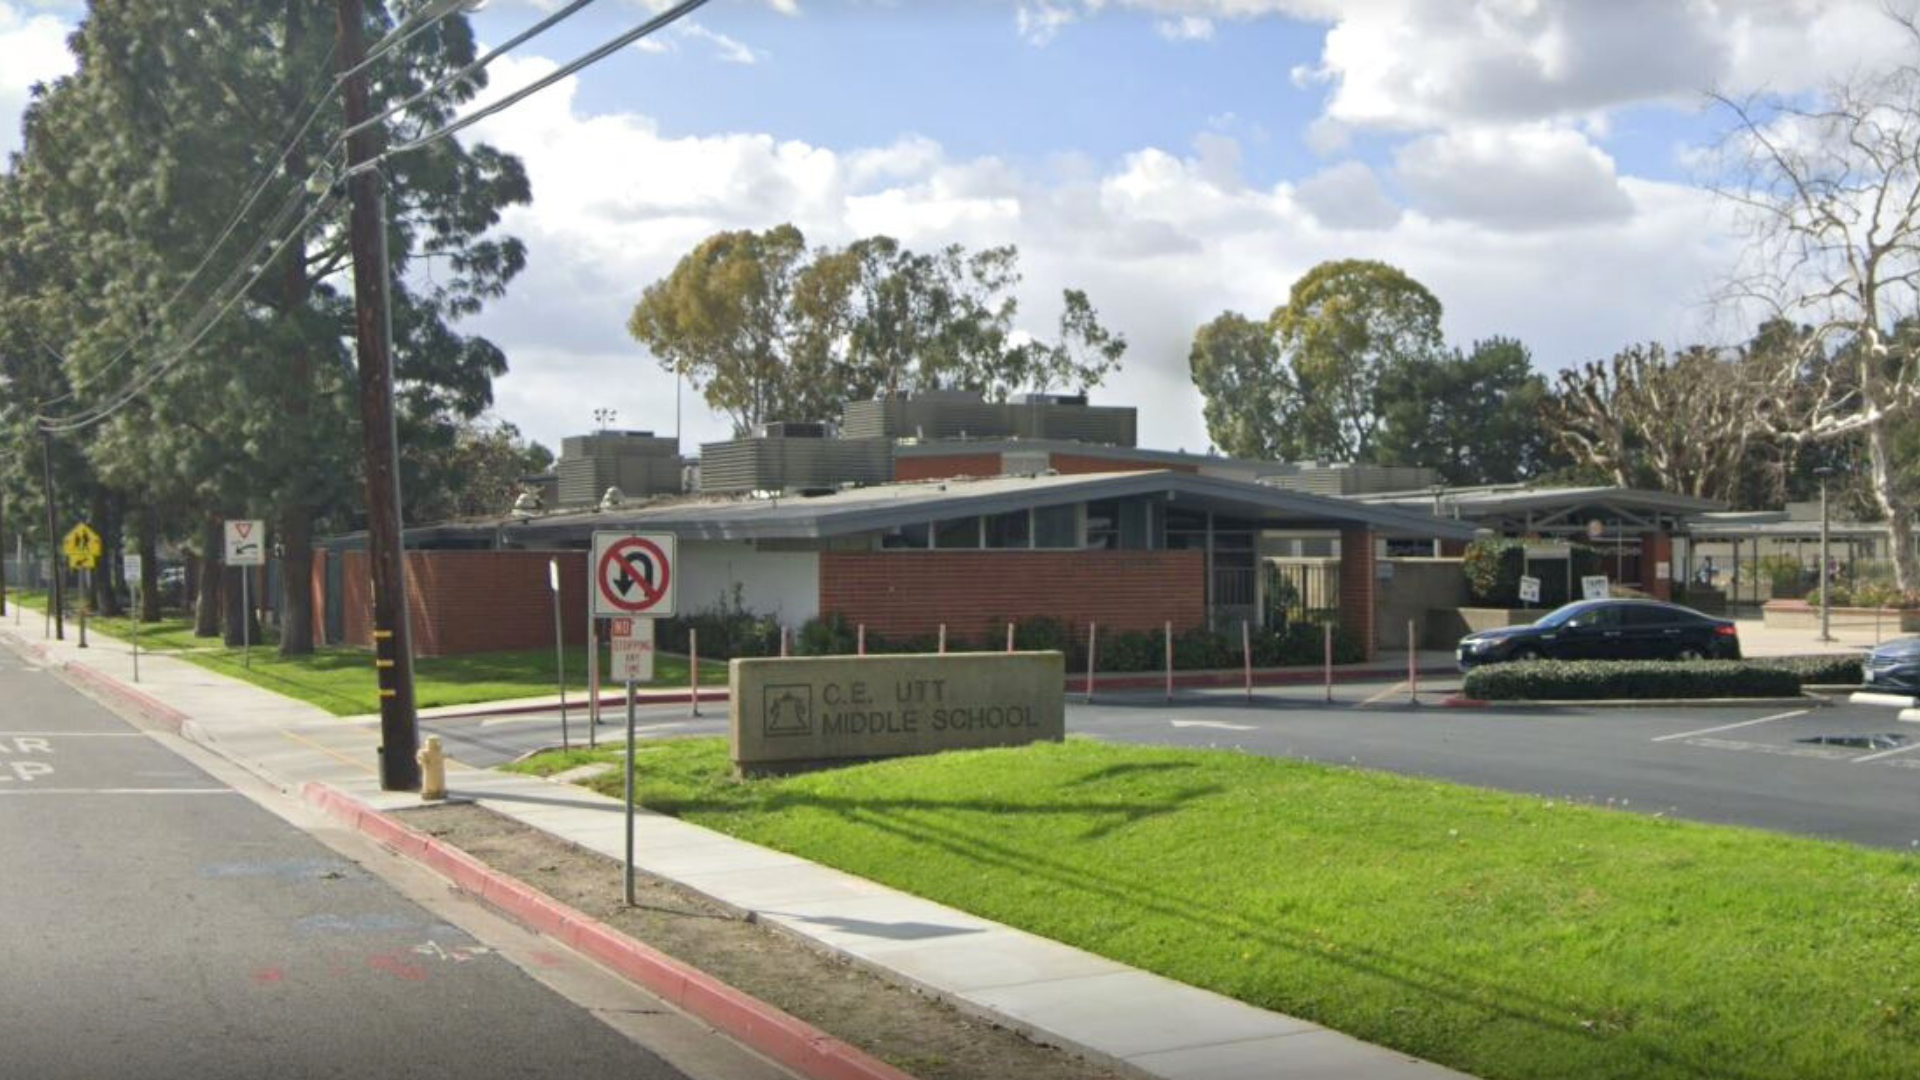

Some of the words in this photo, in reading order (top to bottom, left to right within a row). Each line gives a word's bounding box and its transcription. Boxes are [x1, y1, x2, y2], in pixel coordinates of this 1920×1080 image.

[614, 619, 630, 635] NO
[822, 682, 873, 706] C.E.
[896, 680, 945, 702] UTT
[822, 711, 918, 735] MIDDLE
[931, 706, 1039, 731] SCHOOL
